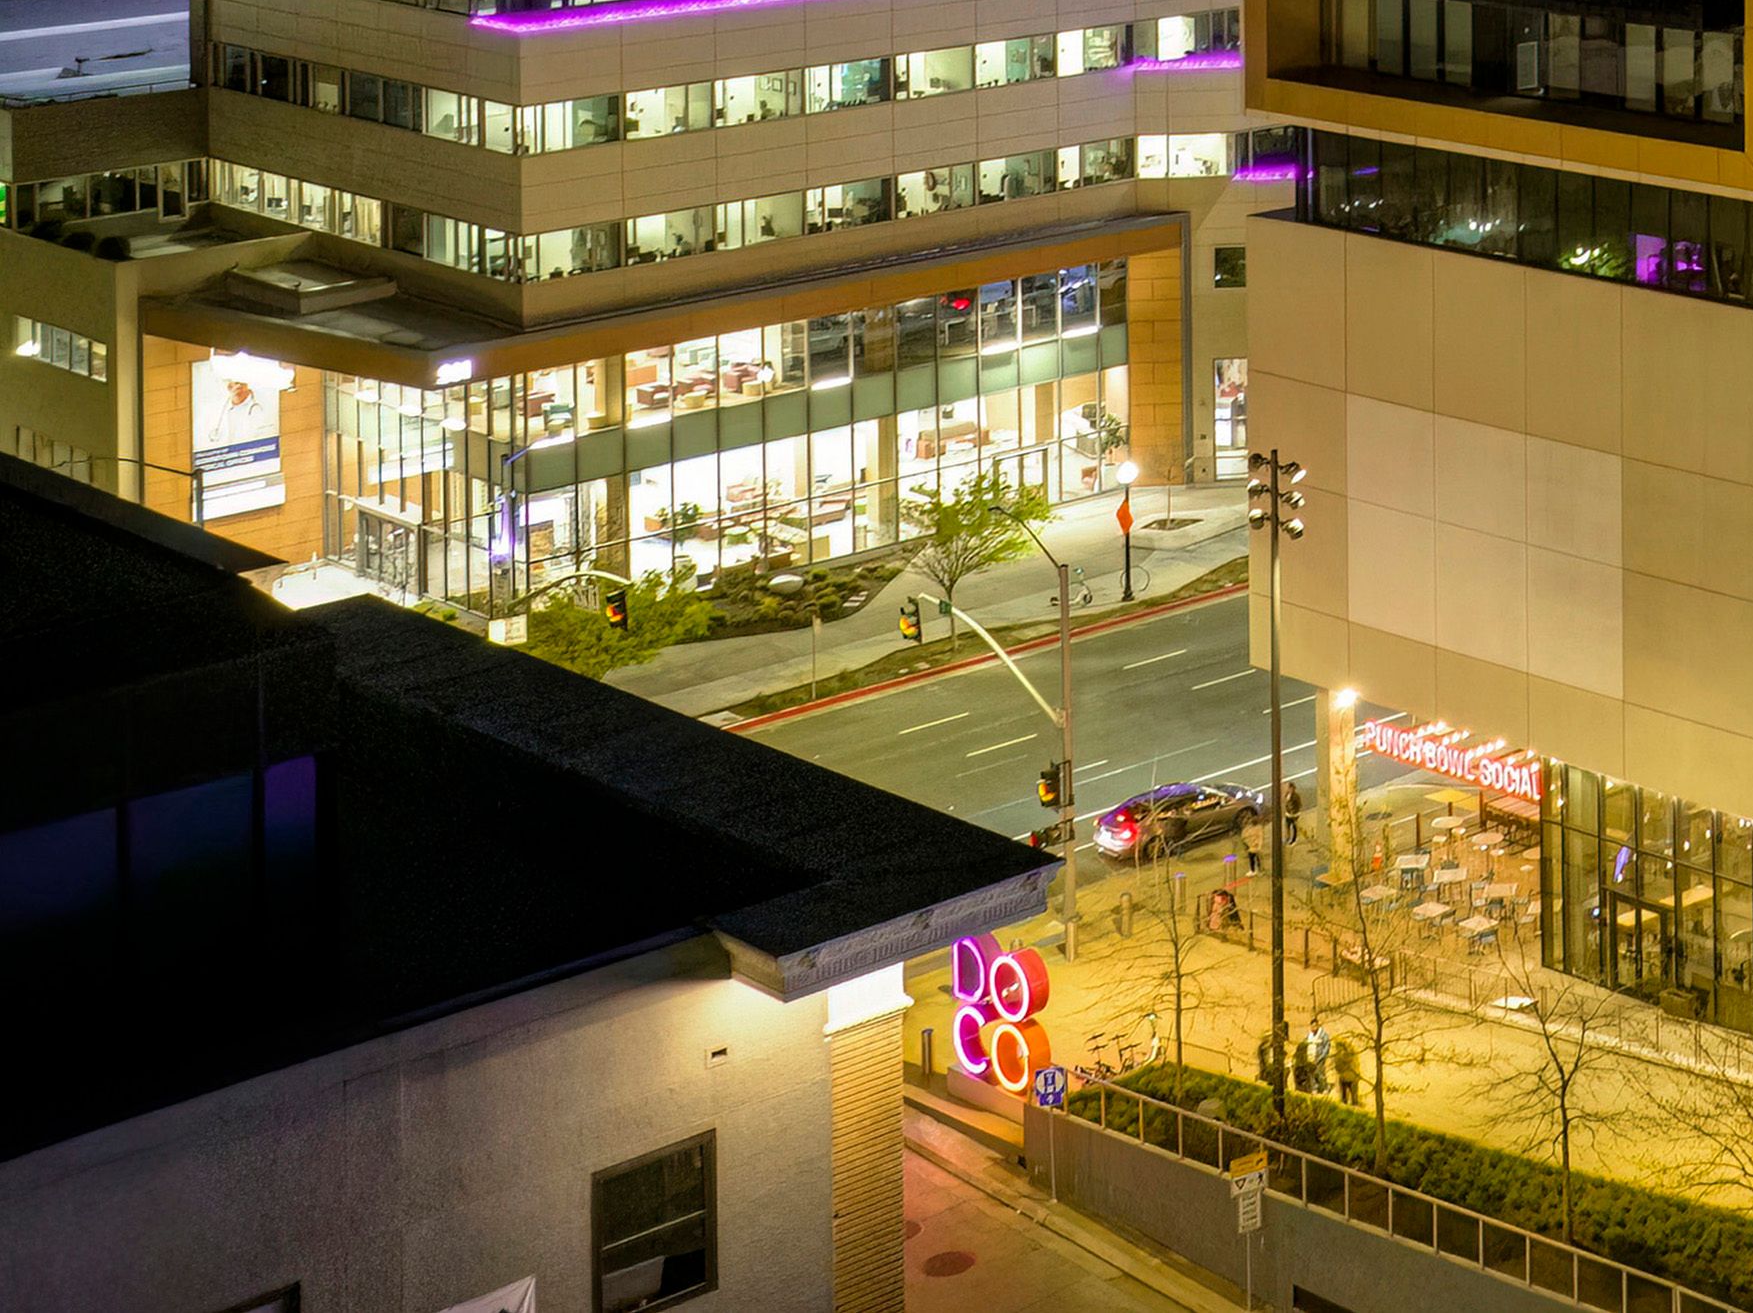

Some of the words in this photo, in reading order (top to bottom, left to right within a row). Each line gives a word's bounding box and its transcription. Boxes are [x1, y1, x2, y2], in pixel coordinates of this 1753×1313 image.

[1364, 721, 1424, 763] PUNCH
[1423, 740, 1476, 780] BOWL
[1479, 757, 1542, 802] SOCIAL
